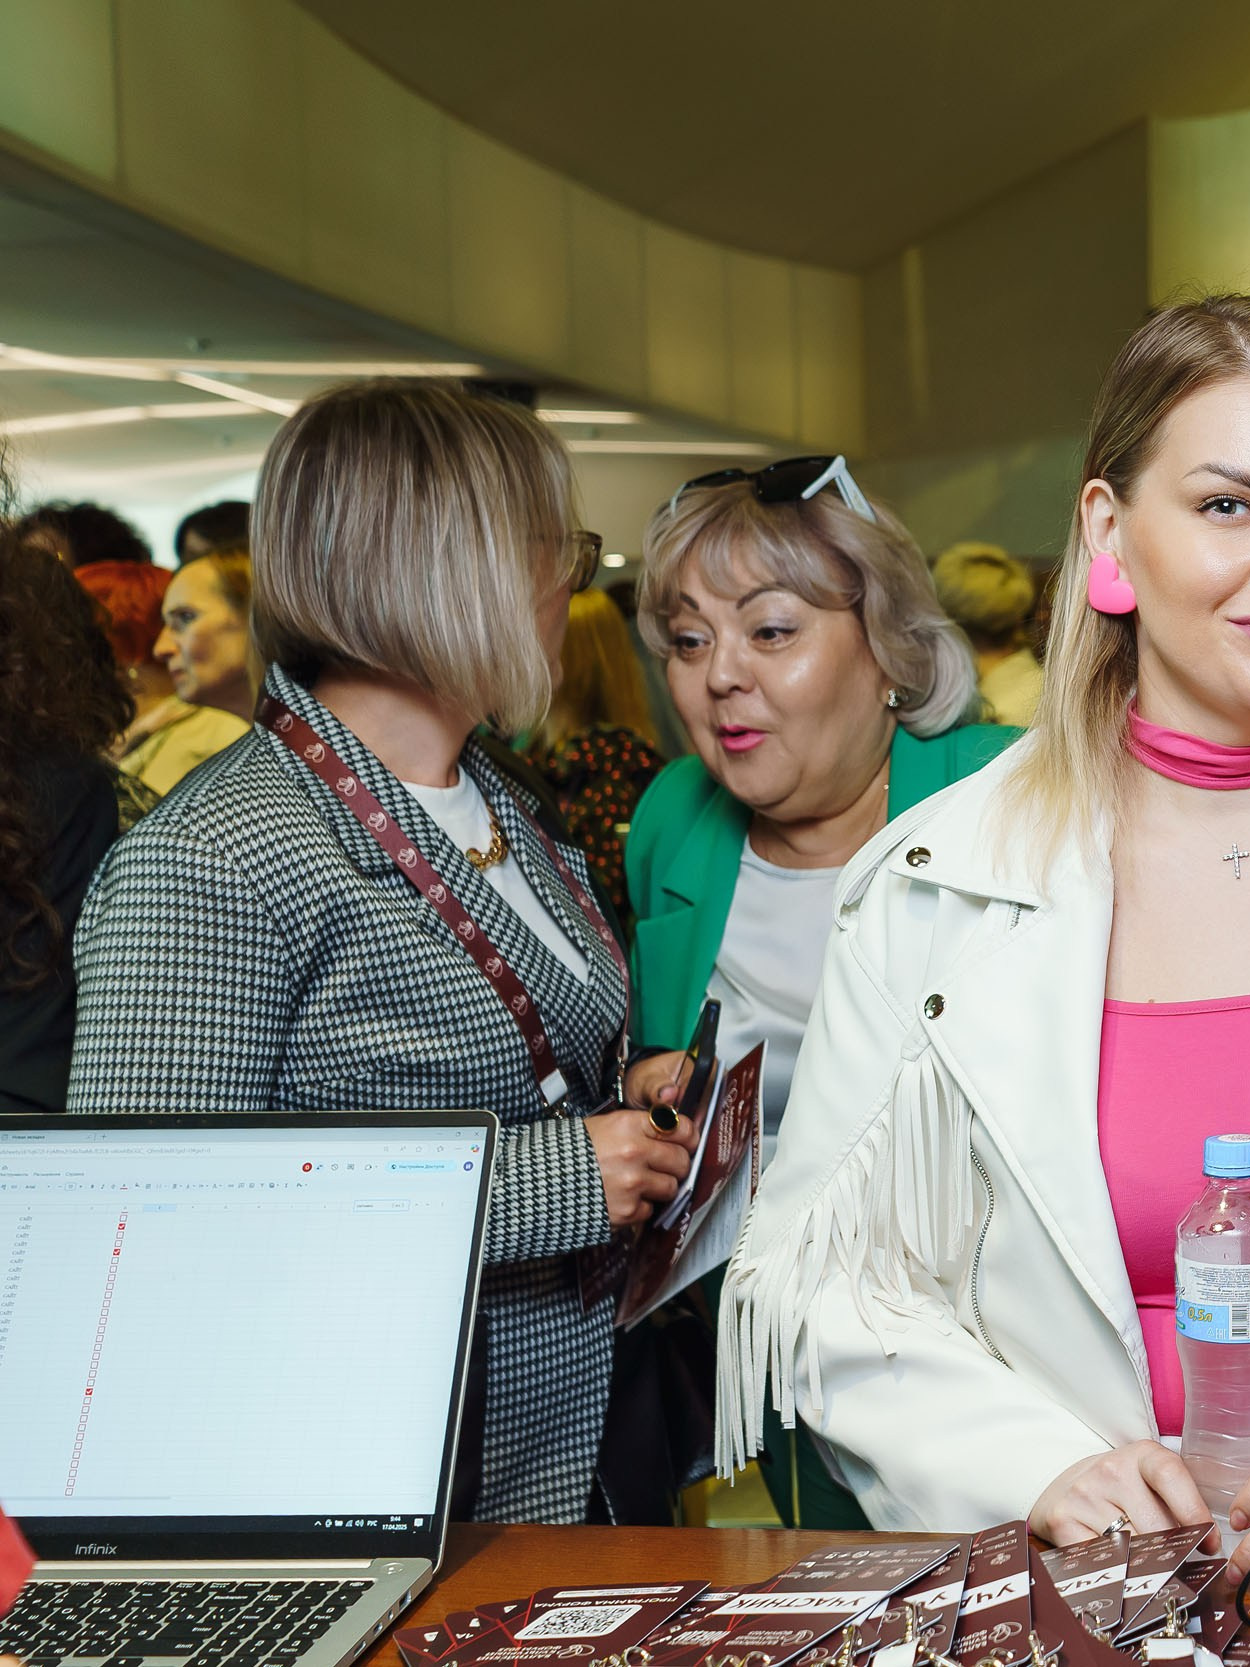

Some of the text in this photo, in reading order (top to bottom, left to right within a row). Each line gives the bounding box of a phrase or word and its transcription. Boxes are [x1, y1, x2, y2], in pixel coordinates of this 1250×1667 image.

[1188, 1307, 1213, 1322] 0,5л
[75, 1543, 118, 1555] Infinix
[534, 1597, 678, 1609] ПРОГРАММА ФОРУМА
[726, 1596, 867, 1609] УЧАСТНИК
